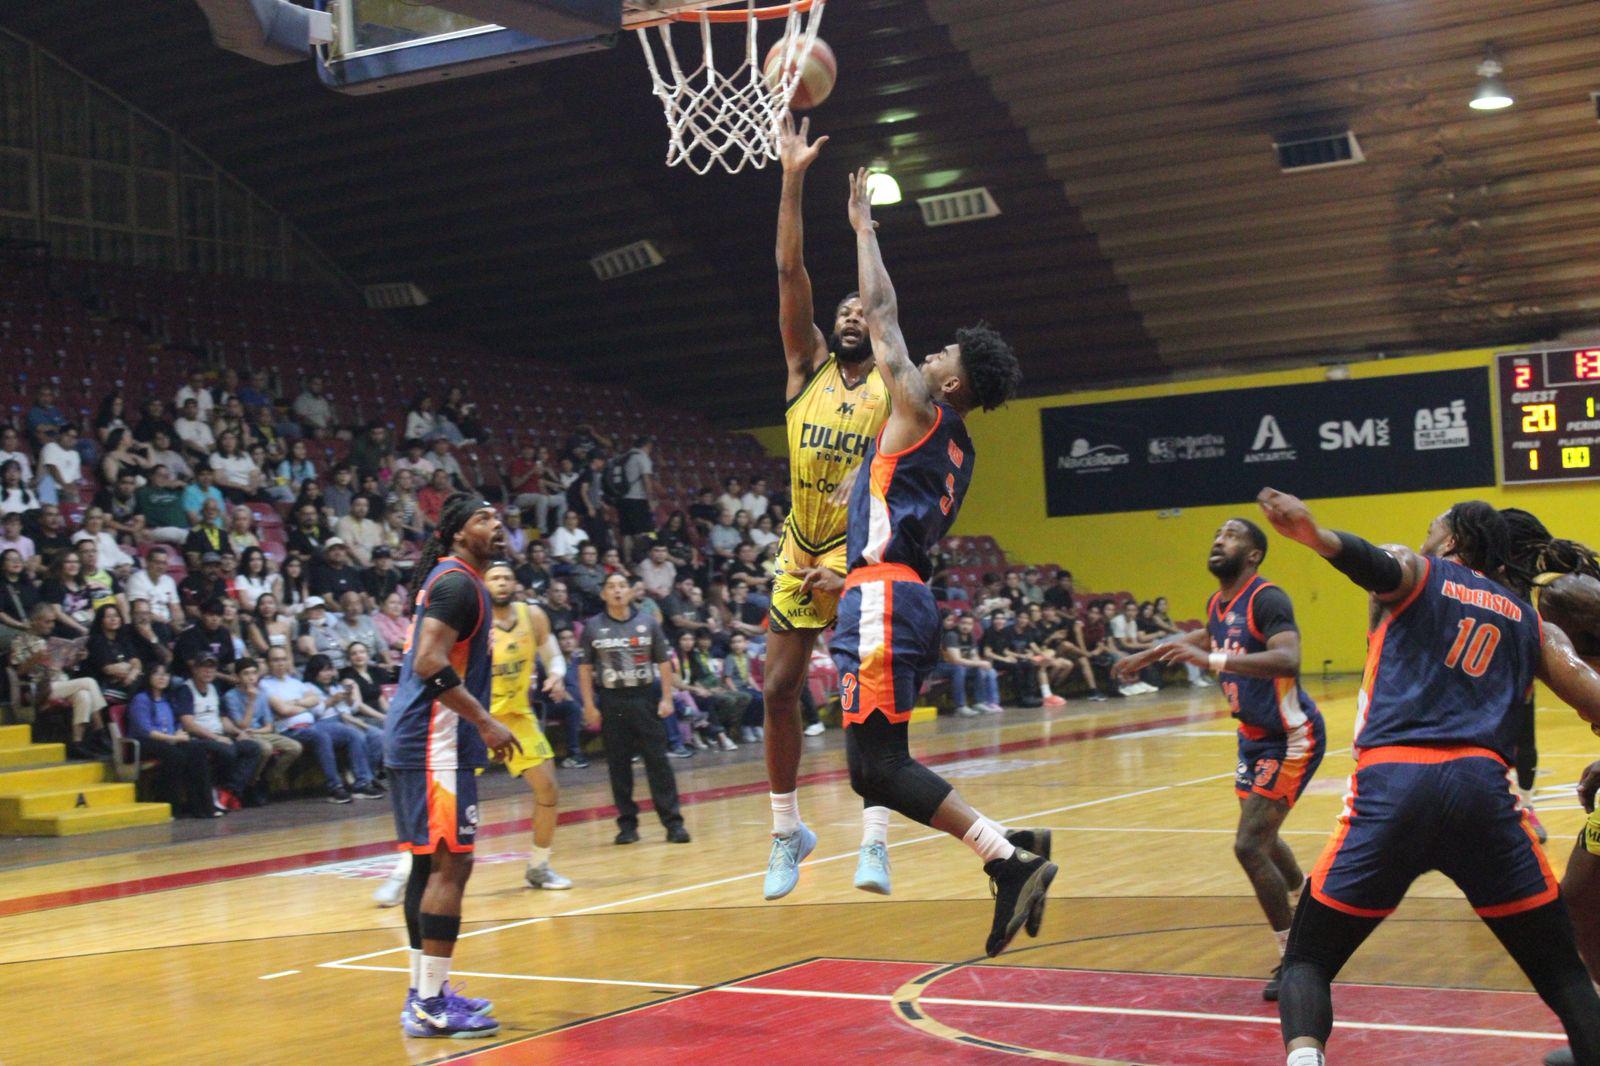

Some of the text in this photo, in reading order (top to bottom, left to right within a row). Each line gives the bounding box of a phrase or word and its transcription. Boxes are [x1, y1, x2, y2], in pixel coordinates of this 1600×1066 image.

[1515, 366, 1530, 388] 2
[1511, 390, 1557, 403] GUEST
[1415, 399, 1467, 430] ASÍ
[1522, 404, 1556, 432] 20
[816, 451, 853, 465] TOWN
[1529, 449, 1538, 471] 1
[786, 607, 819, 618] MEGA
[1441, 579, 1522, 622] ANDERSON
[1444, 617, 1502, 677] 10
[841, 672, 857, 711] 3
